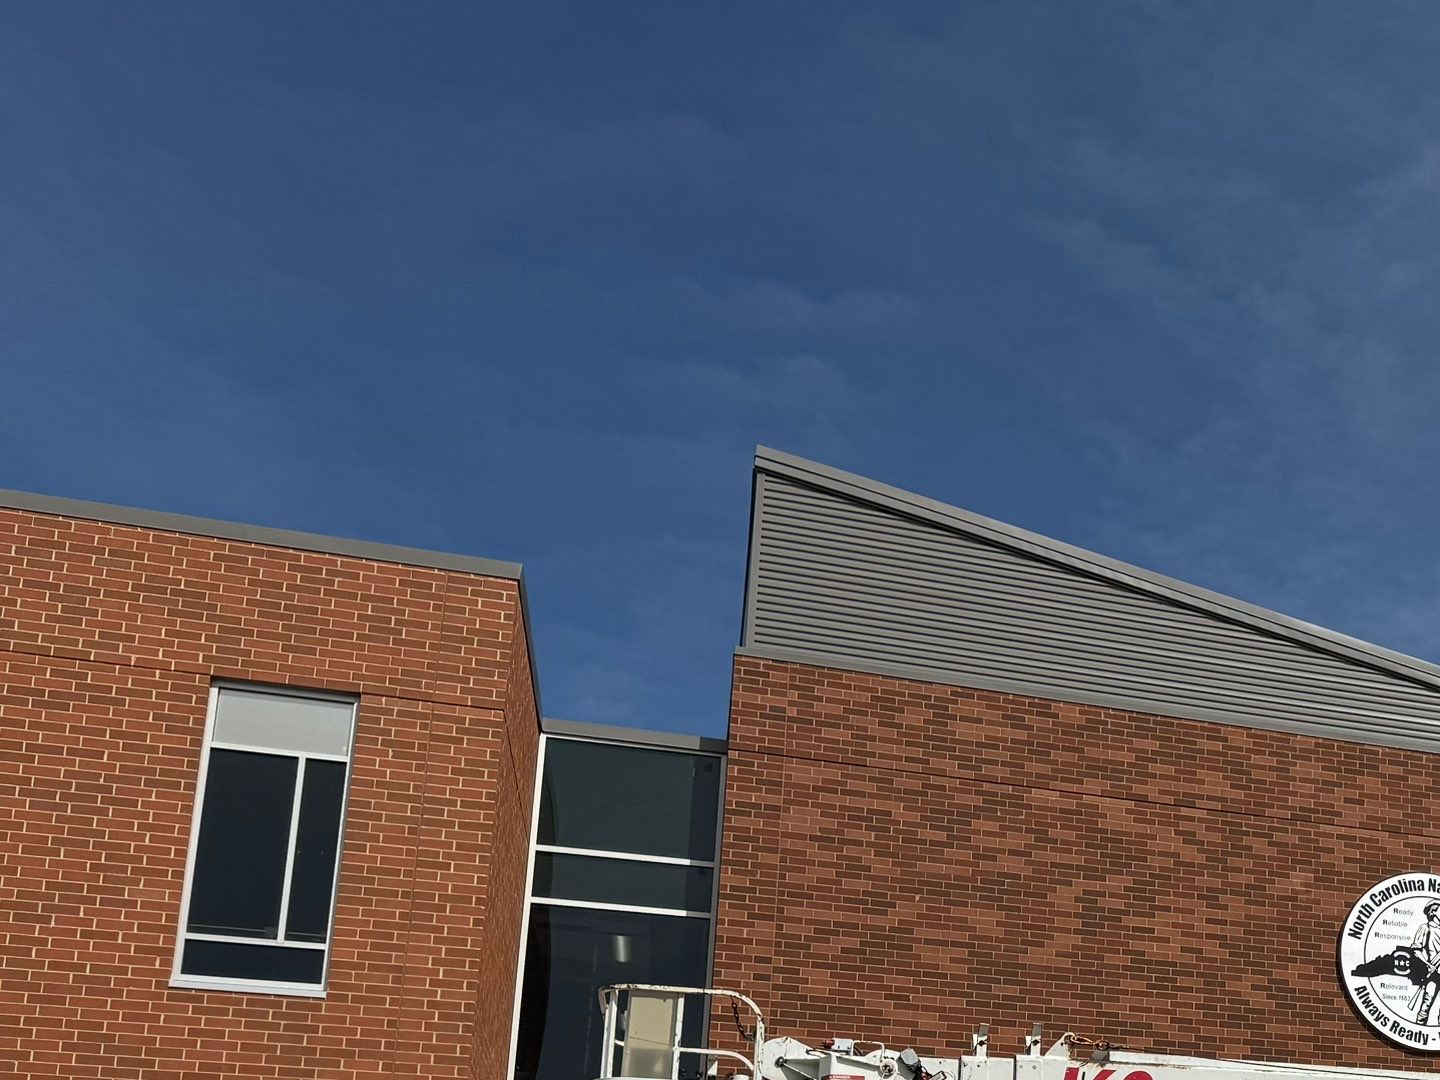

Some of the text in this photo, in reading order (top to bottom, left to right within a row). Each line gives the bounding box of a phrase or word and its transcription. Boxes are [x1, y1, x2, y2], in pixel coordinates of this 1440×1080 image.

[1347, 902, 1375, 940] North
[1369, 878, 1425, 903] Carolina
[1393, 907, 1414, 916] Ready
[1382, 919, 1408, 928] Reliable
[1374, 931, 1411, 941] Responsive
[1380, 982, 1408, 991] Relevant
[1354, 984, 1391, 1028] Always
[1389, 1019, 1429, 1046] Ready
